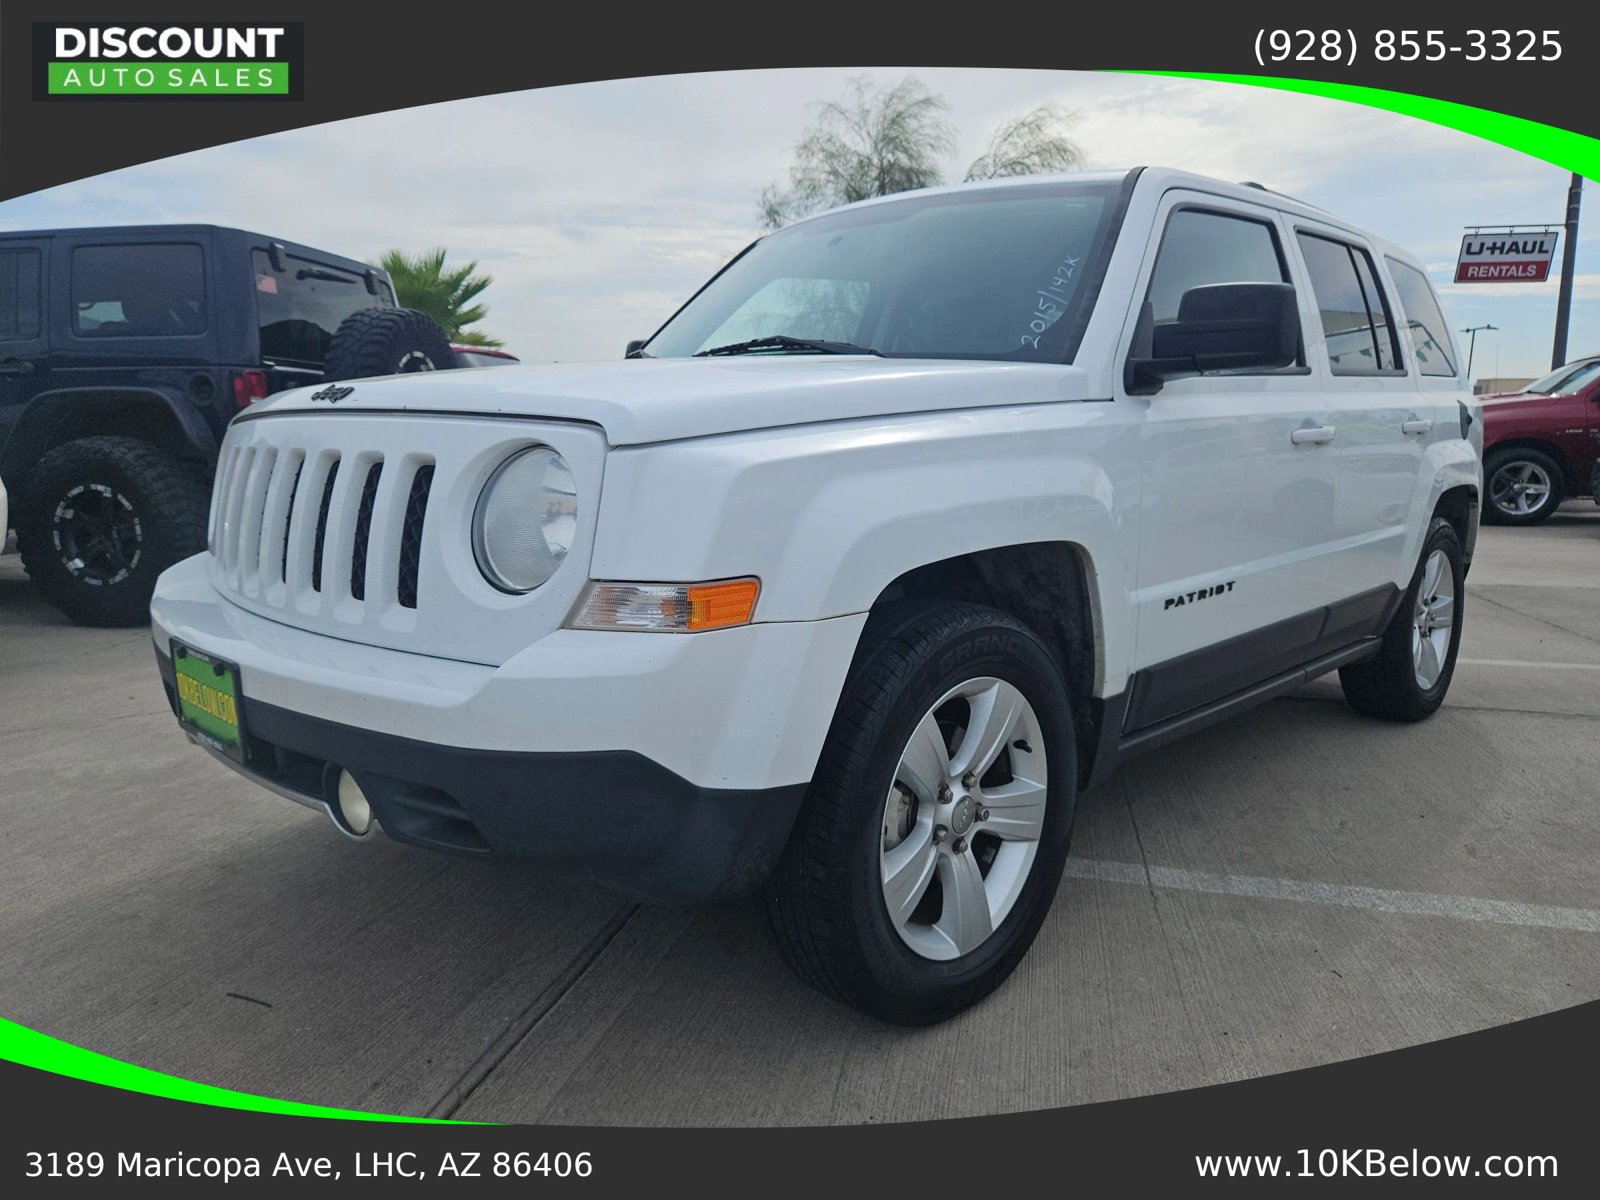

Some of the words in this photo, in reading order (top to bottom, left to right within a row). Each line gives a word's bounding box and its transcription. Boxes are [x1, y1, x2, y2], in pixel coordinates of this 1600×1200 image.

[1465, 240, 1549, 255] U-HAUL
[1467, 265, 1536, 278] RENTALS
[1021, 254, 1080, 349] 2015/142K
[311, 384, 355, 403] Jeep
[1164, 580, 1236, 610] PATRIOT
